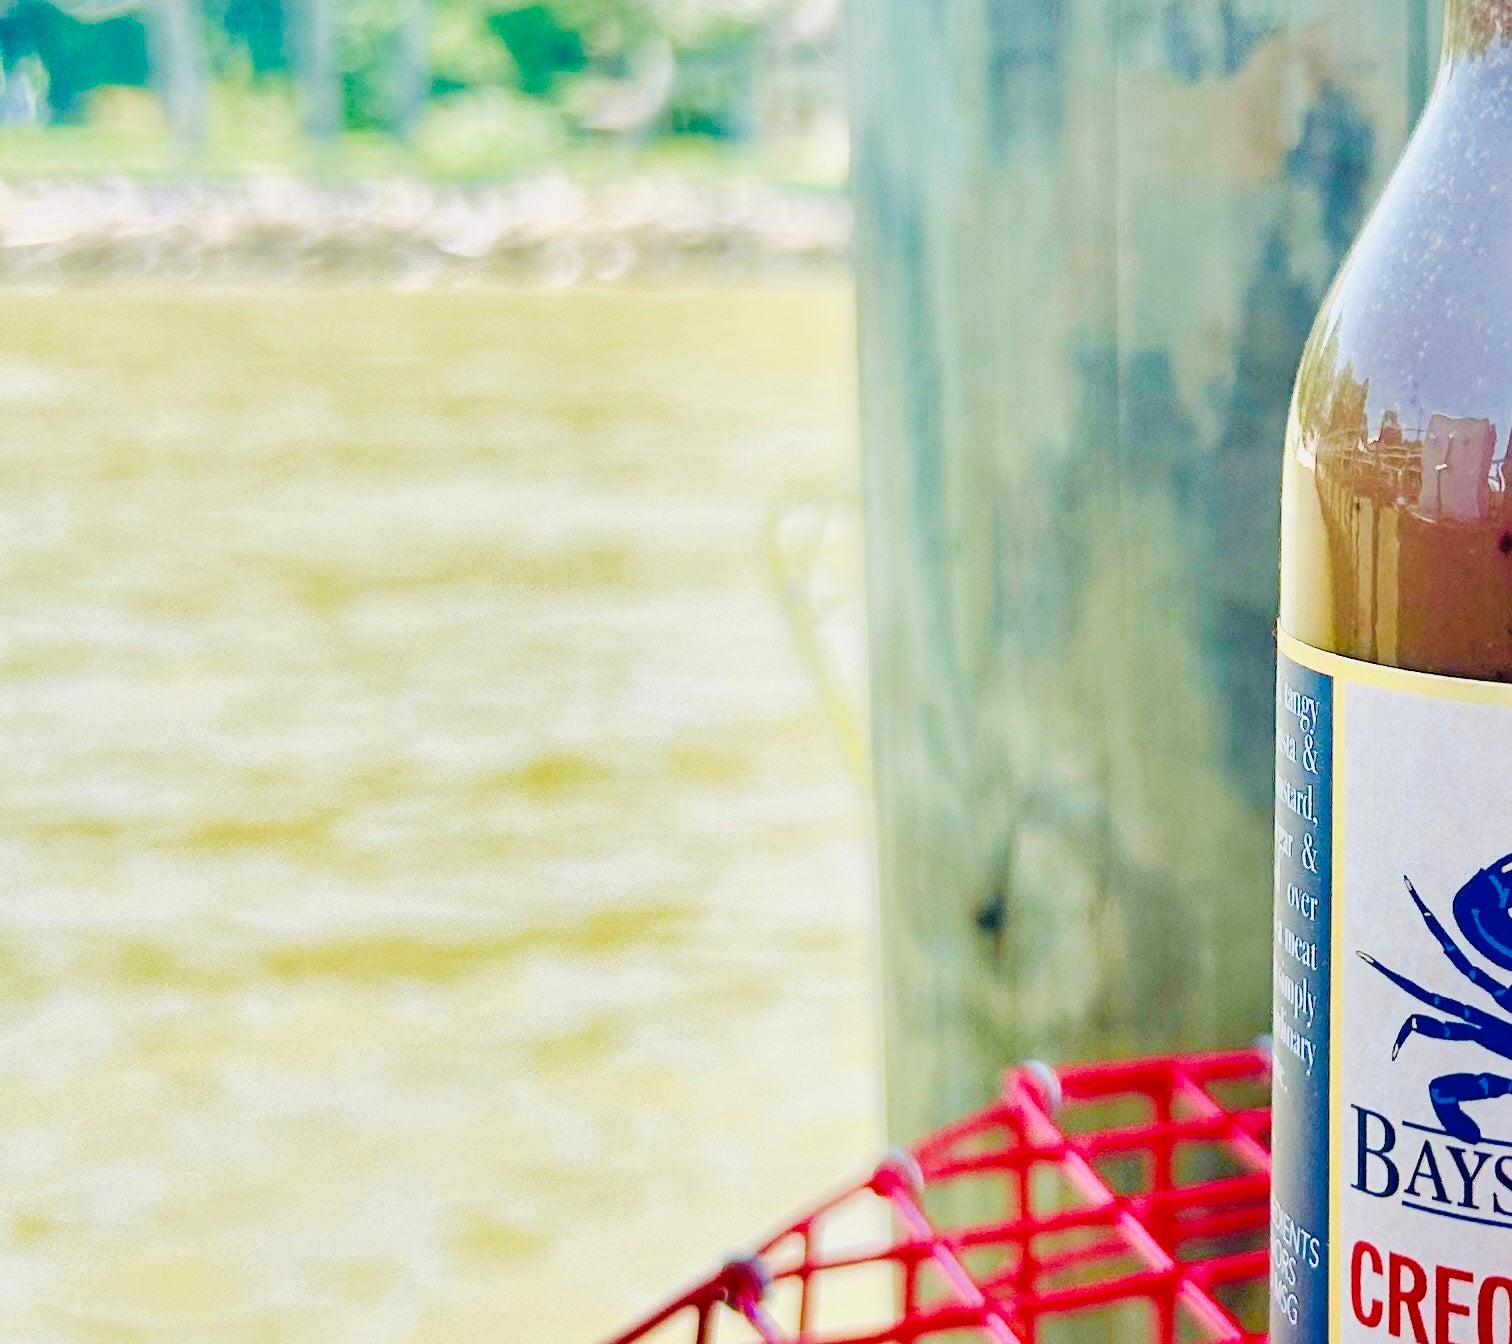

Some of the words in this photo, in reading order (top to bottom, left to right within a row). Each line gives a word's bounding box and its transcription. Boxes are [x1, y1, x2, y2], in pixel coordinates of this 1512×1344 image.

[1302, 734, 1318, 775] &
[1302, 832, 1318, 873] &
[1287, 883, 1318, 921] over
[1284, 927, 1318, 971] meat
